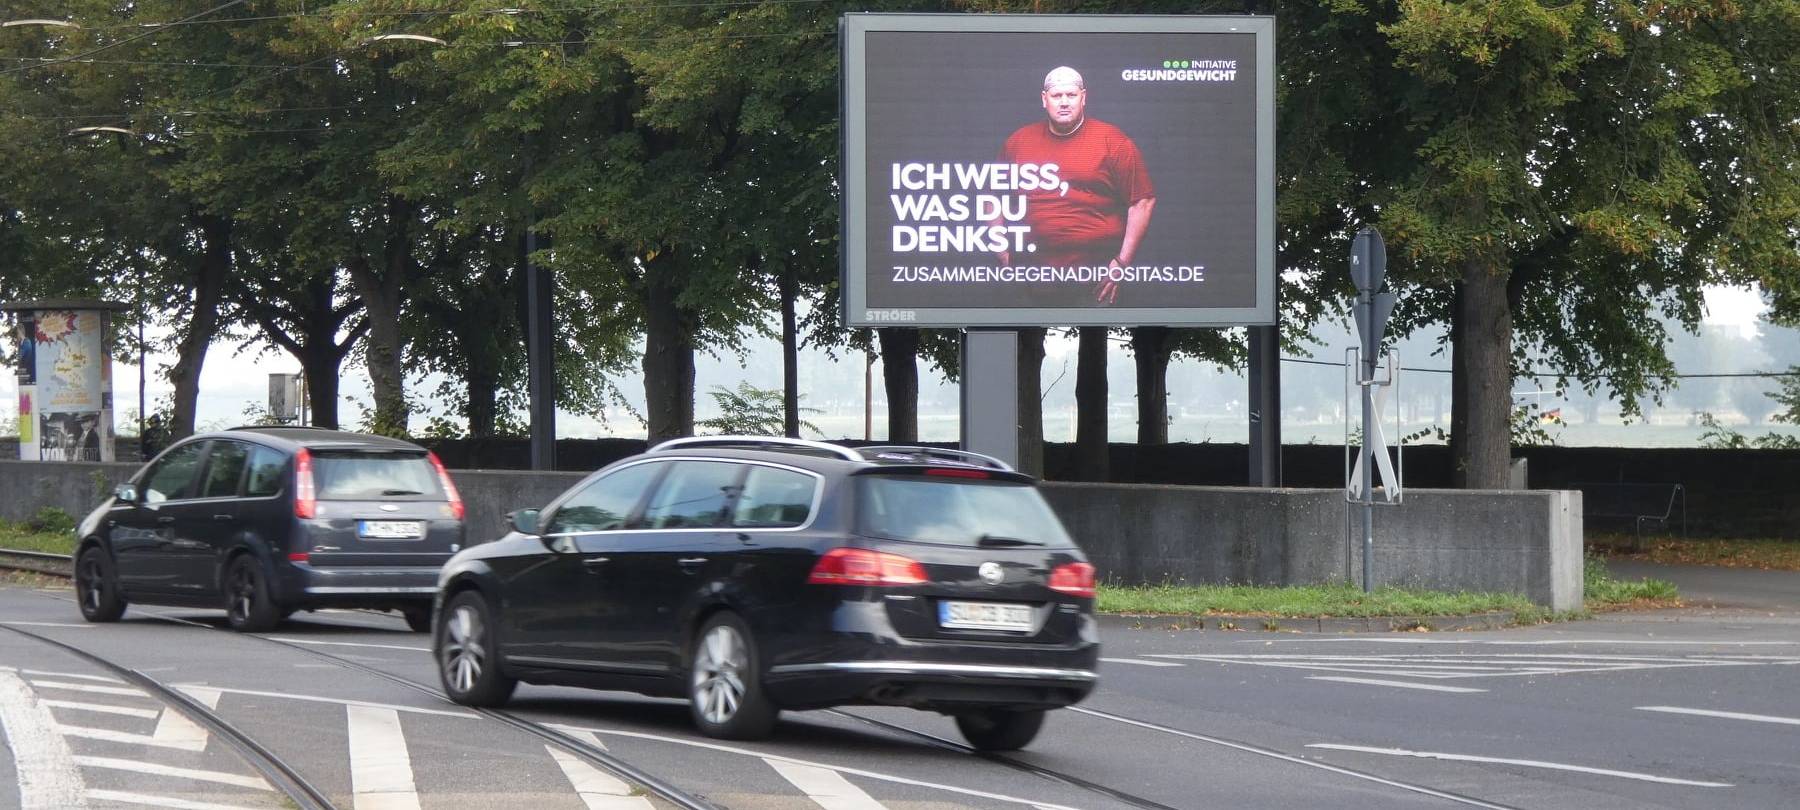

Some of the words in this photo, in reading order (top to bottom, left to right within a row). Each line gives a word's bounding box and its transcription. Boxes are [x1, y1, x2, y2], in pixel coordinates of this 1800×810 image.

[1191, 60, 1237, 70] INITIATIVE
[1122, 70, 1236, 82] GESUNDGEWICHT
[892, 163, 950, 190] ICH
[955, 163, 1069, 196] WEISS,
[891, 195, 969, 222] WAS
[976, 195, 1027, 222] DU
[892, 226, 1036, 253] DENKST.
[892, 266, 1204, 283] ZUSAMMENGEGENADIPOSITAS.DE
[866, 309, 916, 321] STRÖER
